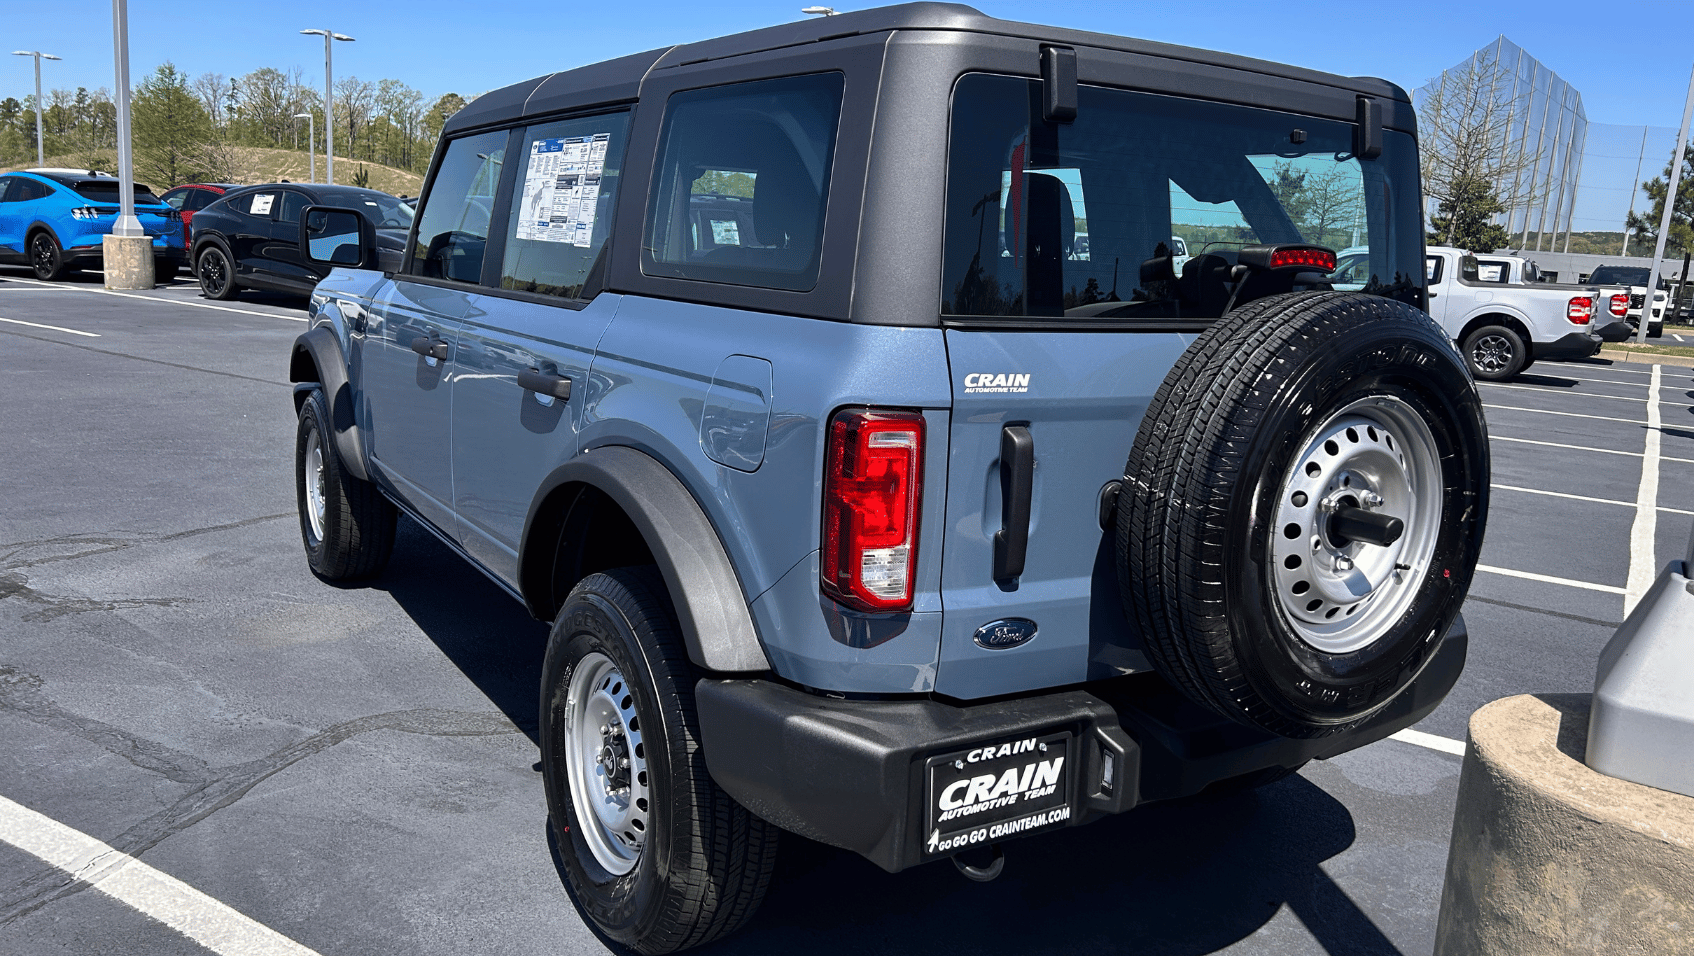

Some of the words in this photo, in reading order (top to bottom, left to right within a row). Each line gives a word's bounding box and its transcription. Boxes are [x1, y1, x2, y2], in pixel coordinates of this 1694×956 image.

[964, 373, 1031, 388] CRAIN
[967, 738, 1037, 763] CRAIN
[938, 757, 1065, 811] CRAIN
[938, 794, 1018, 822] AUTOMOTIVE
[1024, 784, 1057, 801] TEAM
[938, 839, 952, 851] GO
[952, 834, 968, 847] GO
[969, 829, 987, 844] GO
[989, 806, 1071, 839] CRAINTEAM.COM
